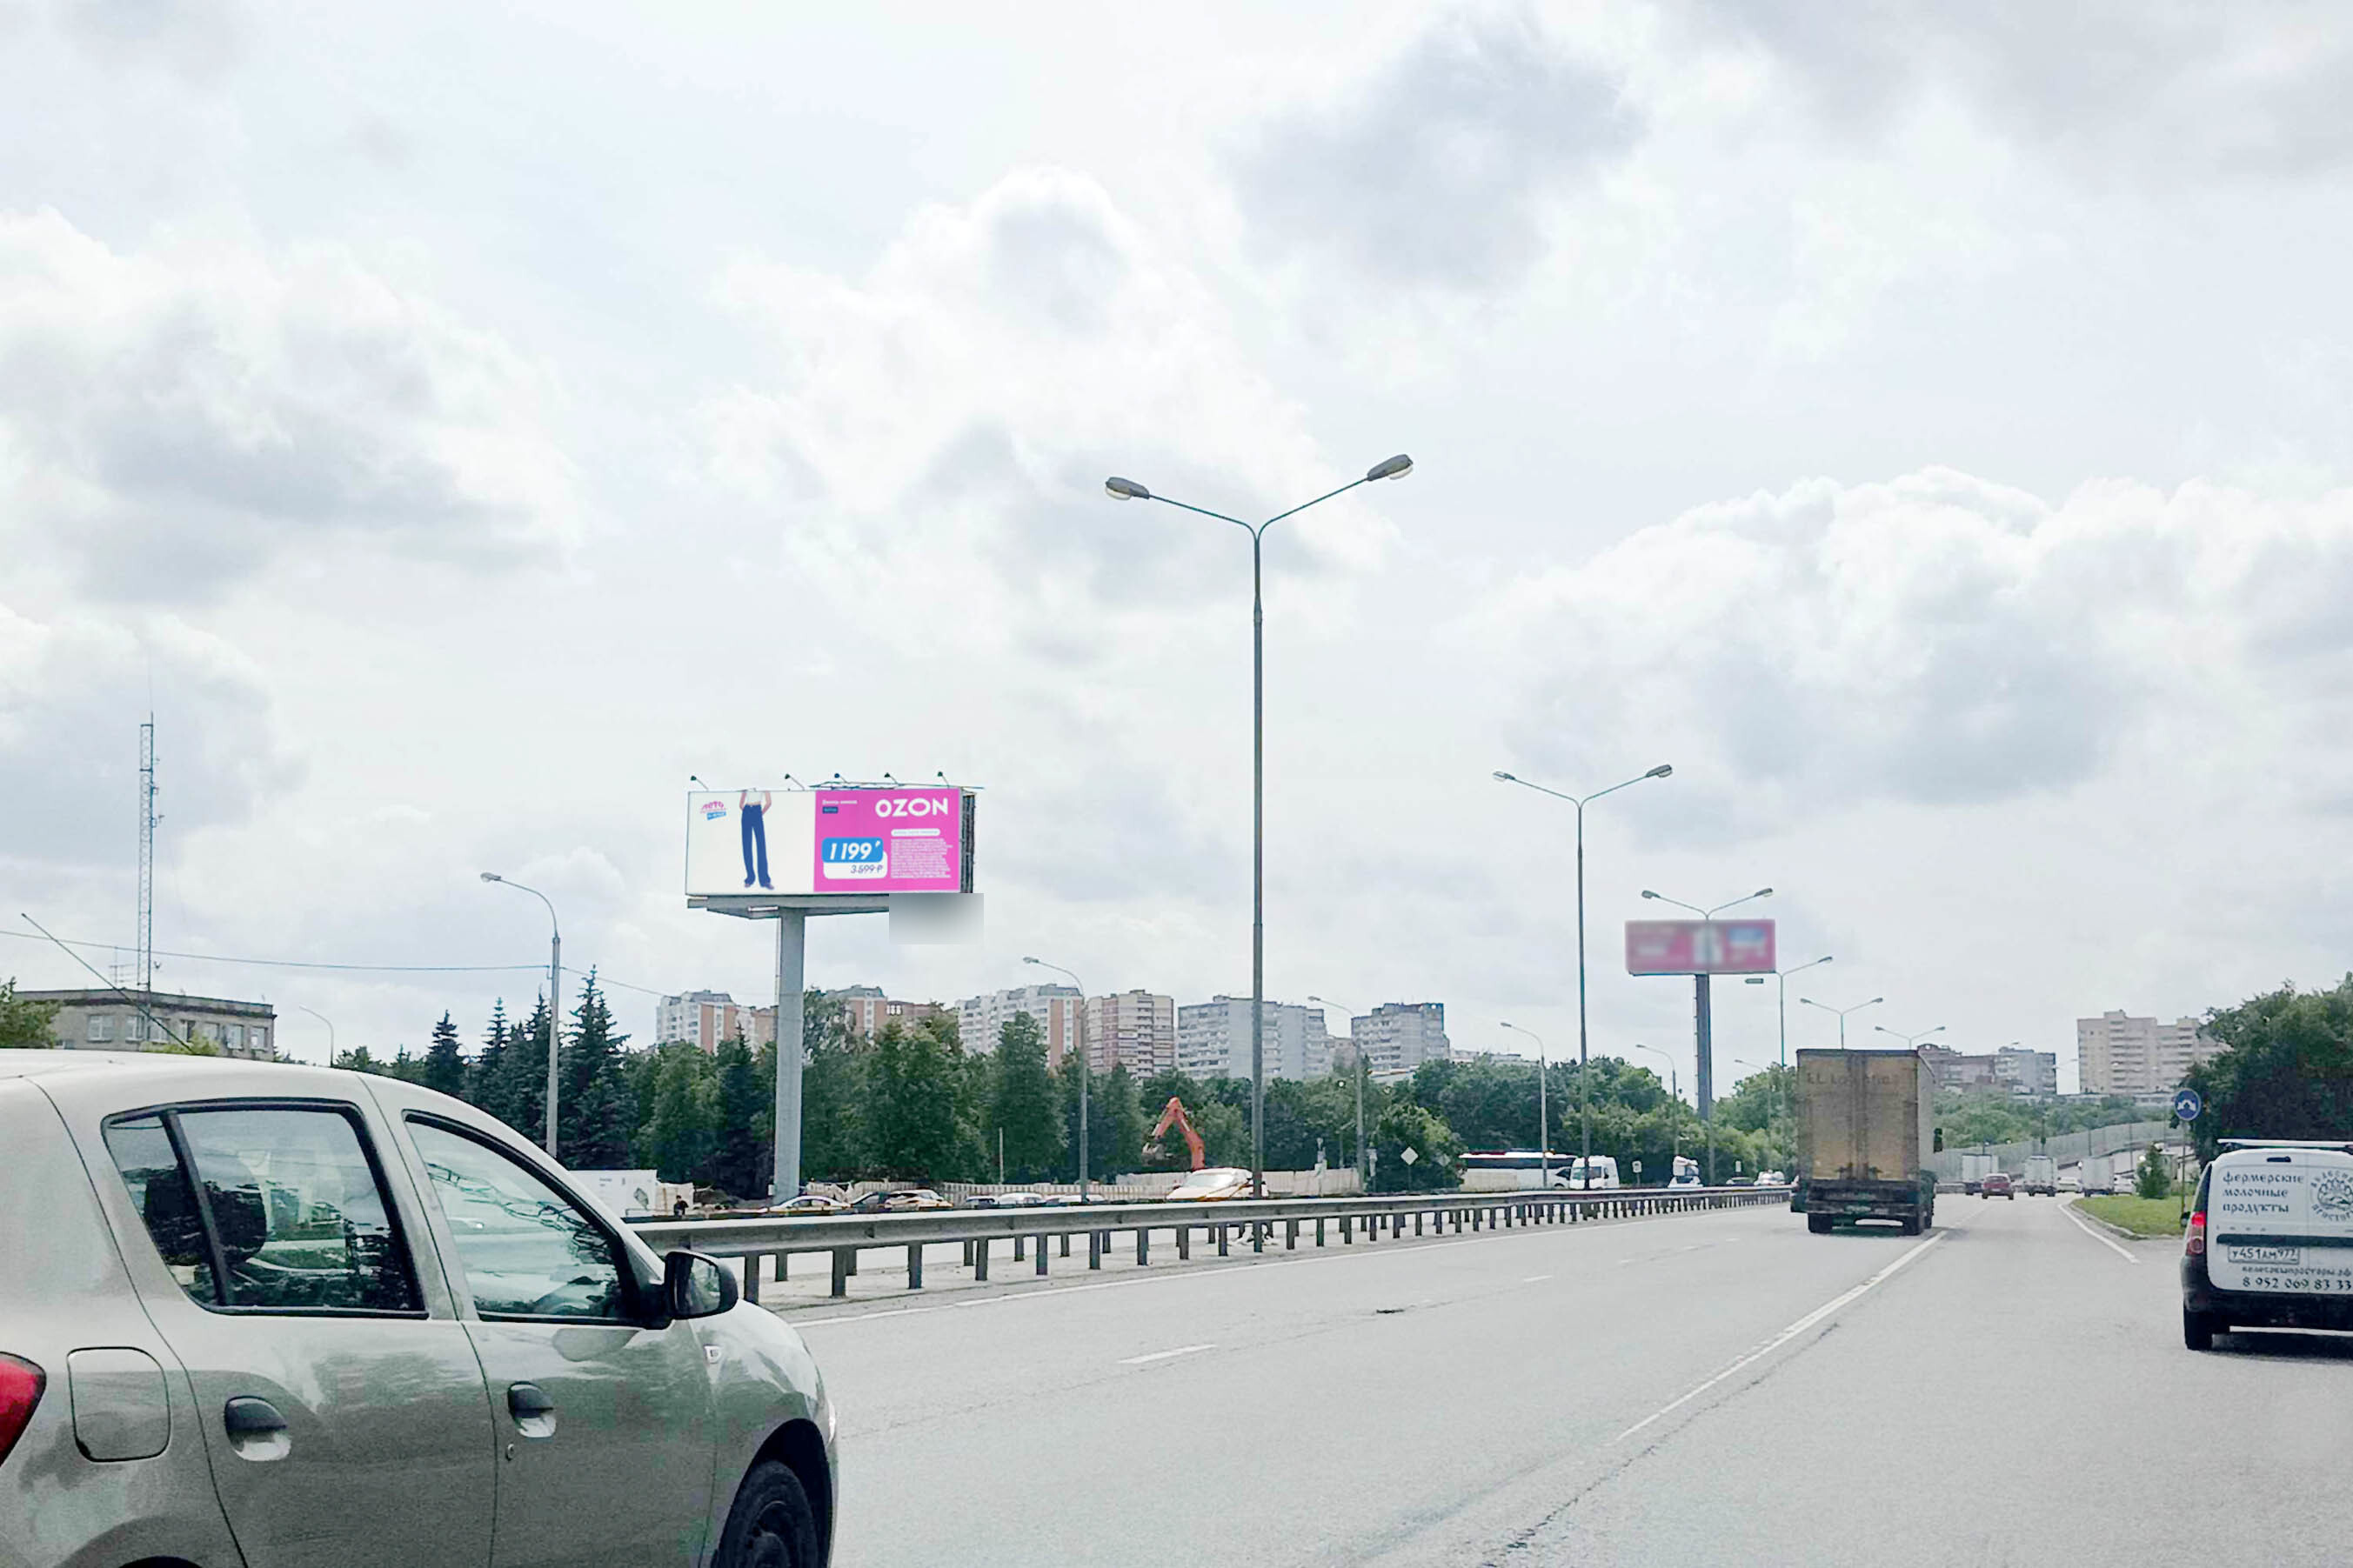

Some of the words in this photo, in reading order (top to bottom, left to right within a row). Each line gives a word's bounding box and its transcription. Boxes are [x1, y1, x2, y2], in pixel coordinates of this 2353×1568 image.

[874, 797, 948, 817] OZON
[2223, 1171, 2304, 1184] фермерские
[2223, 1188, 2289, 1198] молочные
[2223, 1203, 2289, 1215] продукты
[2242, 1276, 2250, 1287] 8
[2255, 1277, 2279, 1289] 952
[2284, 1278, 2310, 1289] 069
[2314, 1279, 2330, 1291] 83
[2336, 1280, 2351, 1291] 33
